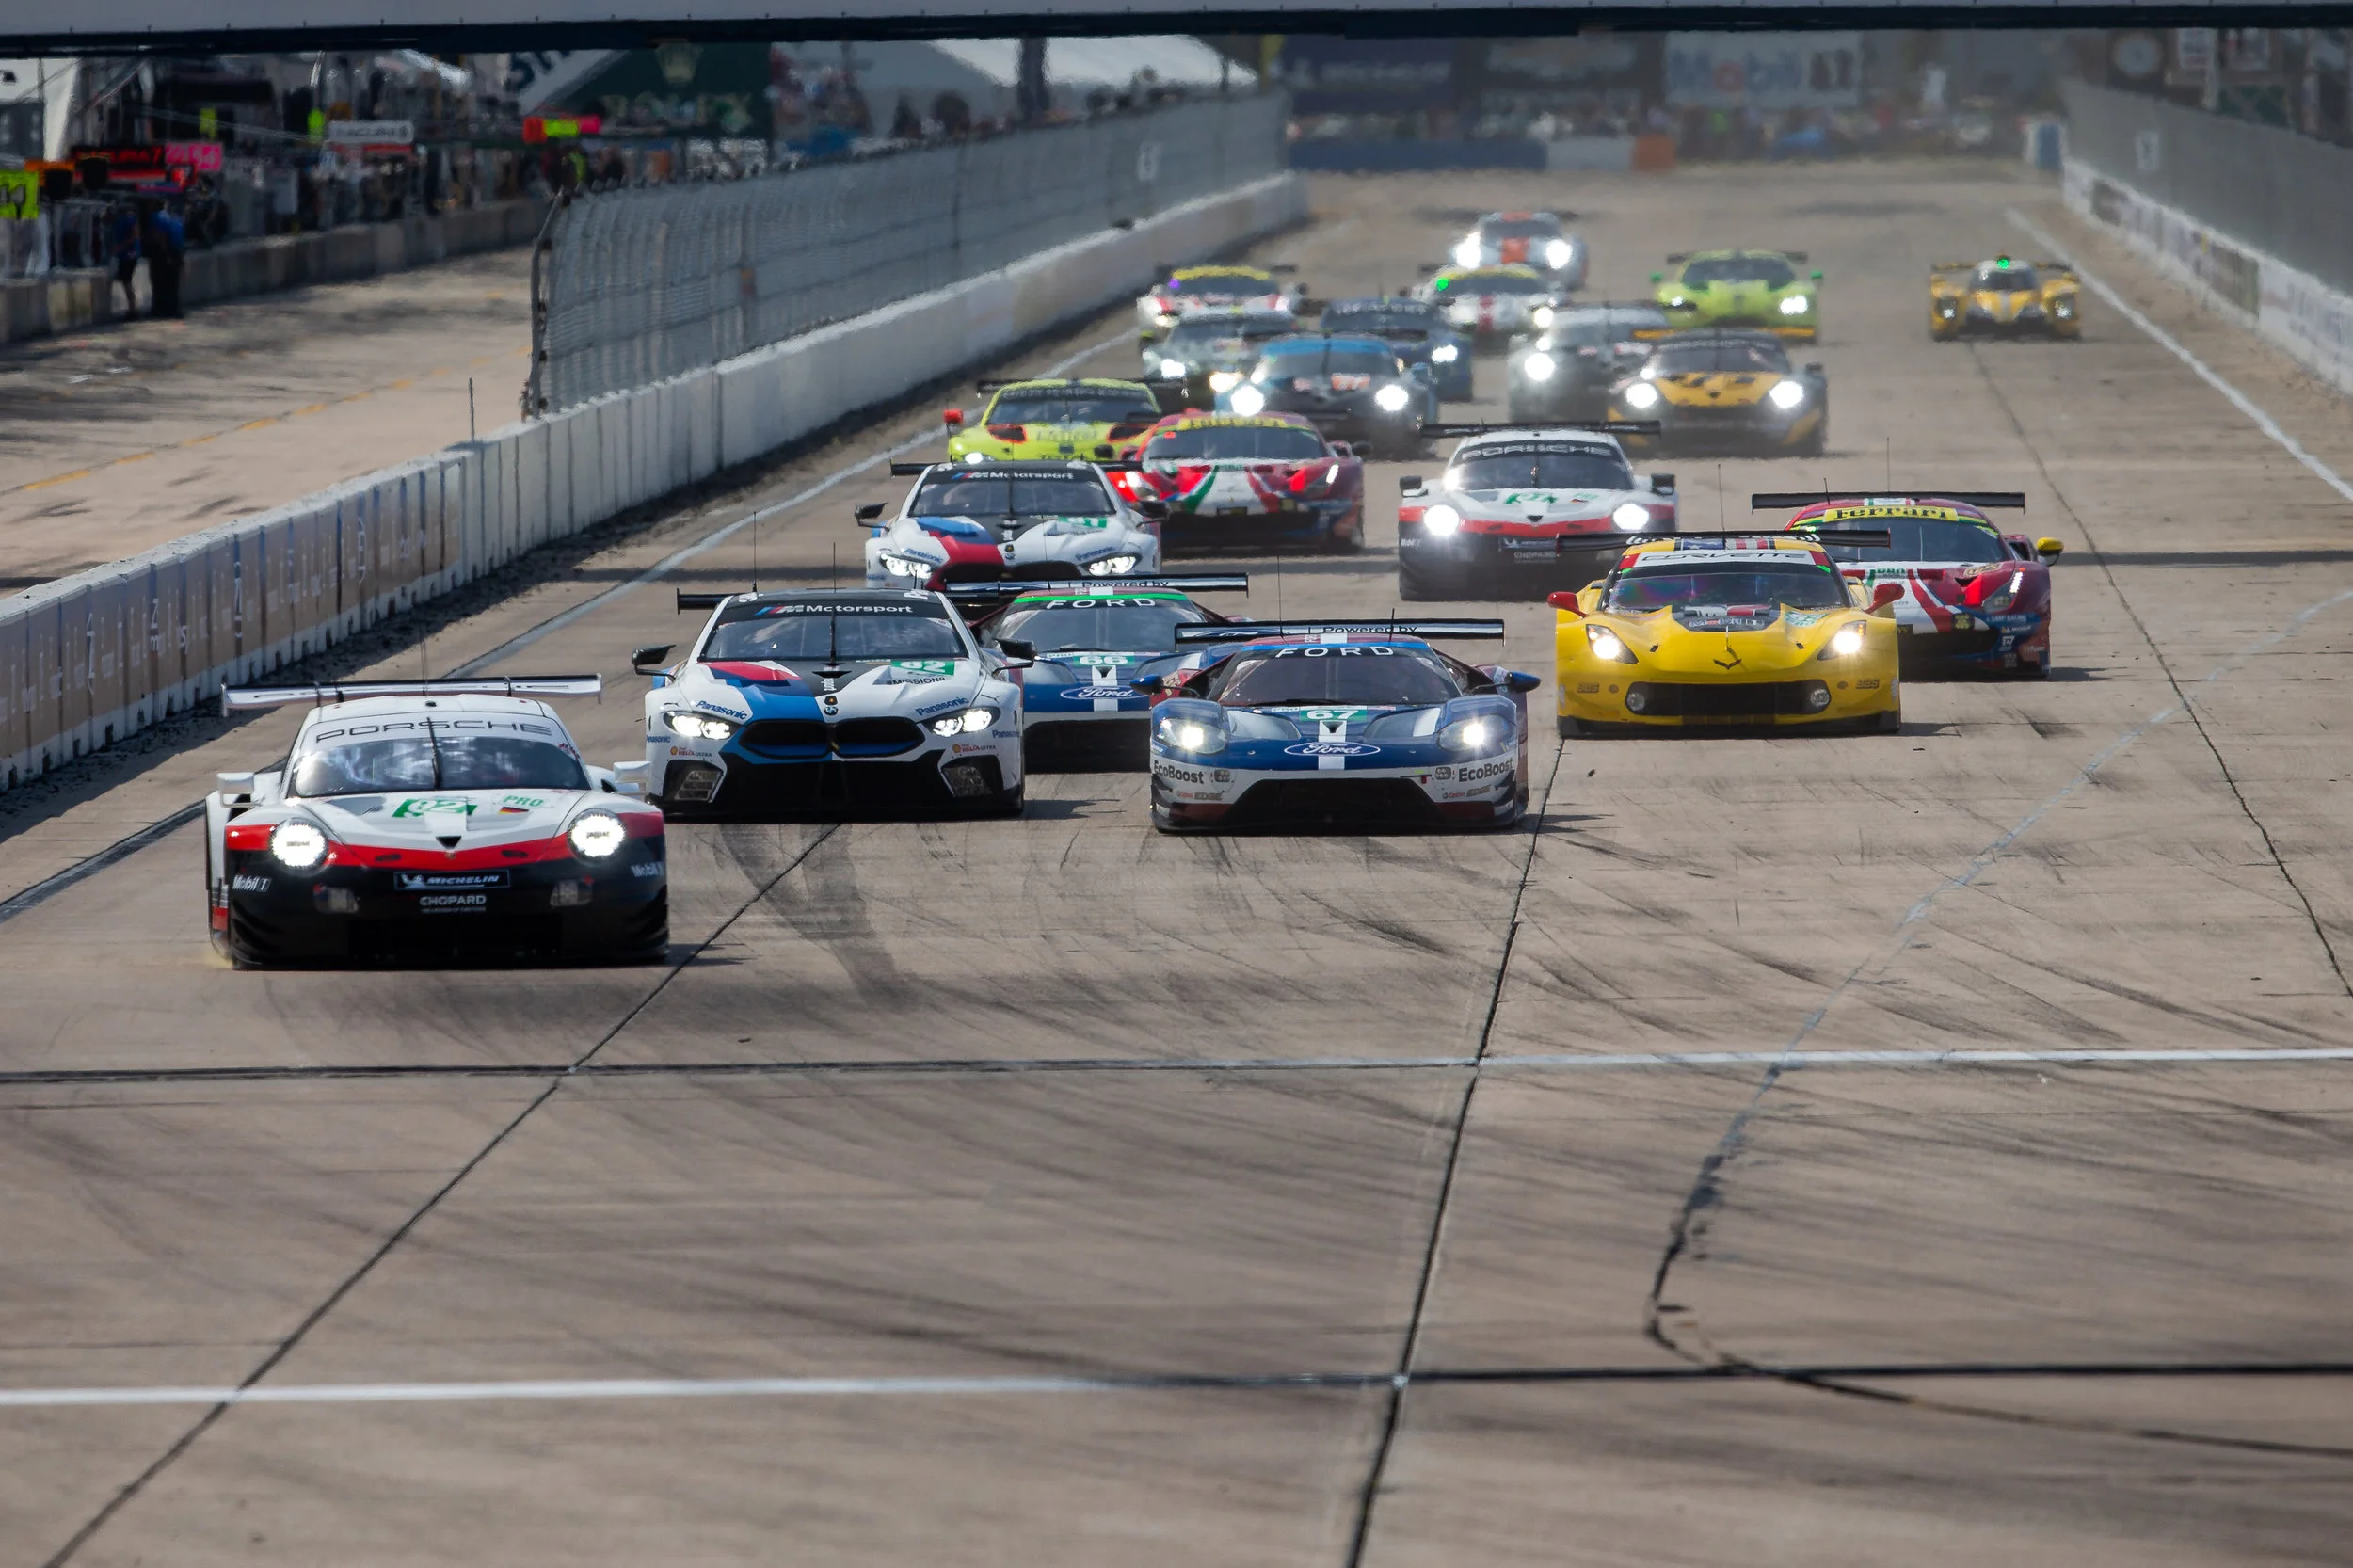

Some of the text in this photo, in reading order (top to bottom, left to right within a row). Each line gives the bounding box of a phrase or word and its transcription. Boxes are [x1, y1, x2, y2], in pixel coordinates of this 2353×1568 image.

[1081, 580, 1169, 588] Powered by
[1046, 599, 1156, 610] FORD
[806, 605, 913, 616] Motorsport
[1275, 647, 1394, 658] FORD
[1079, 655, 1128, 665] 66
[1079, 686, 1134, 698] Ford
[696, 700, 749, 720] Panasonic
[915, 696, 970, 715] Panasonic
[1306, 710, 1359, 720] 67
[316, 720, 552, 743] PORSCHE
[1302, 743, 1363, 754] Ford
[1153, 760, 1204, 785] EcoBoost
[1458, 757, 1514, 783] EcoBoost
[503, 794, 545, 808] PRO
[232, 874, 259, 890] Mobil
[427, 875, 500, 884] MICHELIN
[420, 895, 487, 905] CHOPARD
